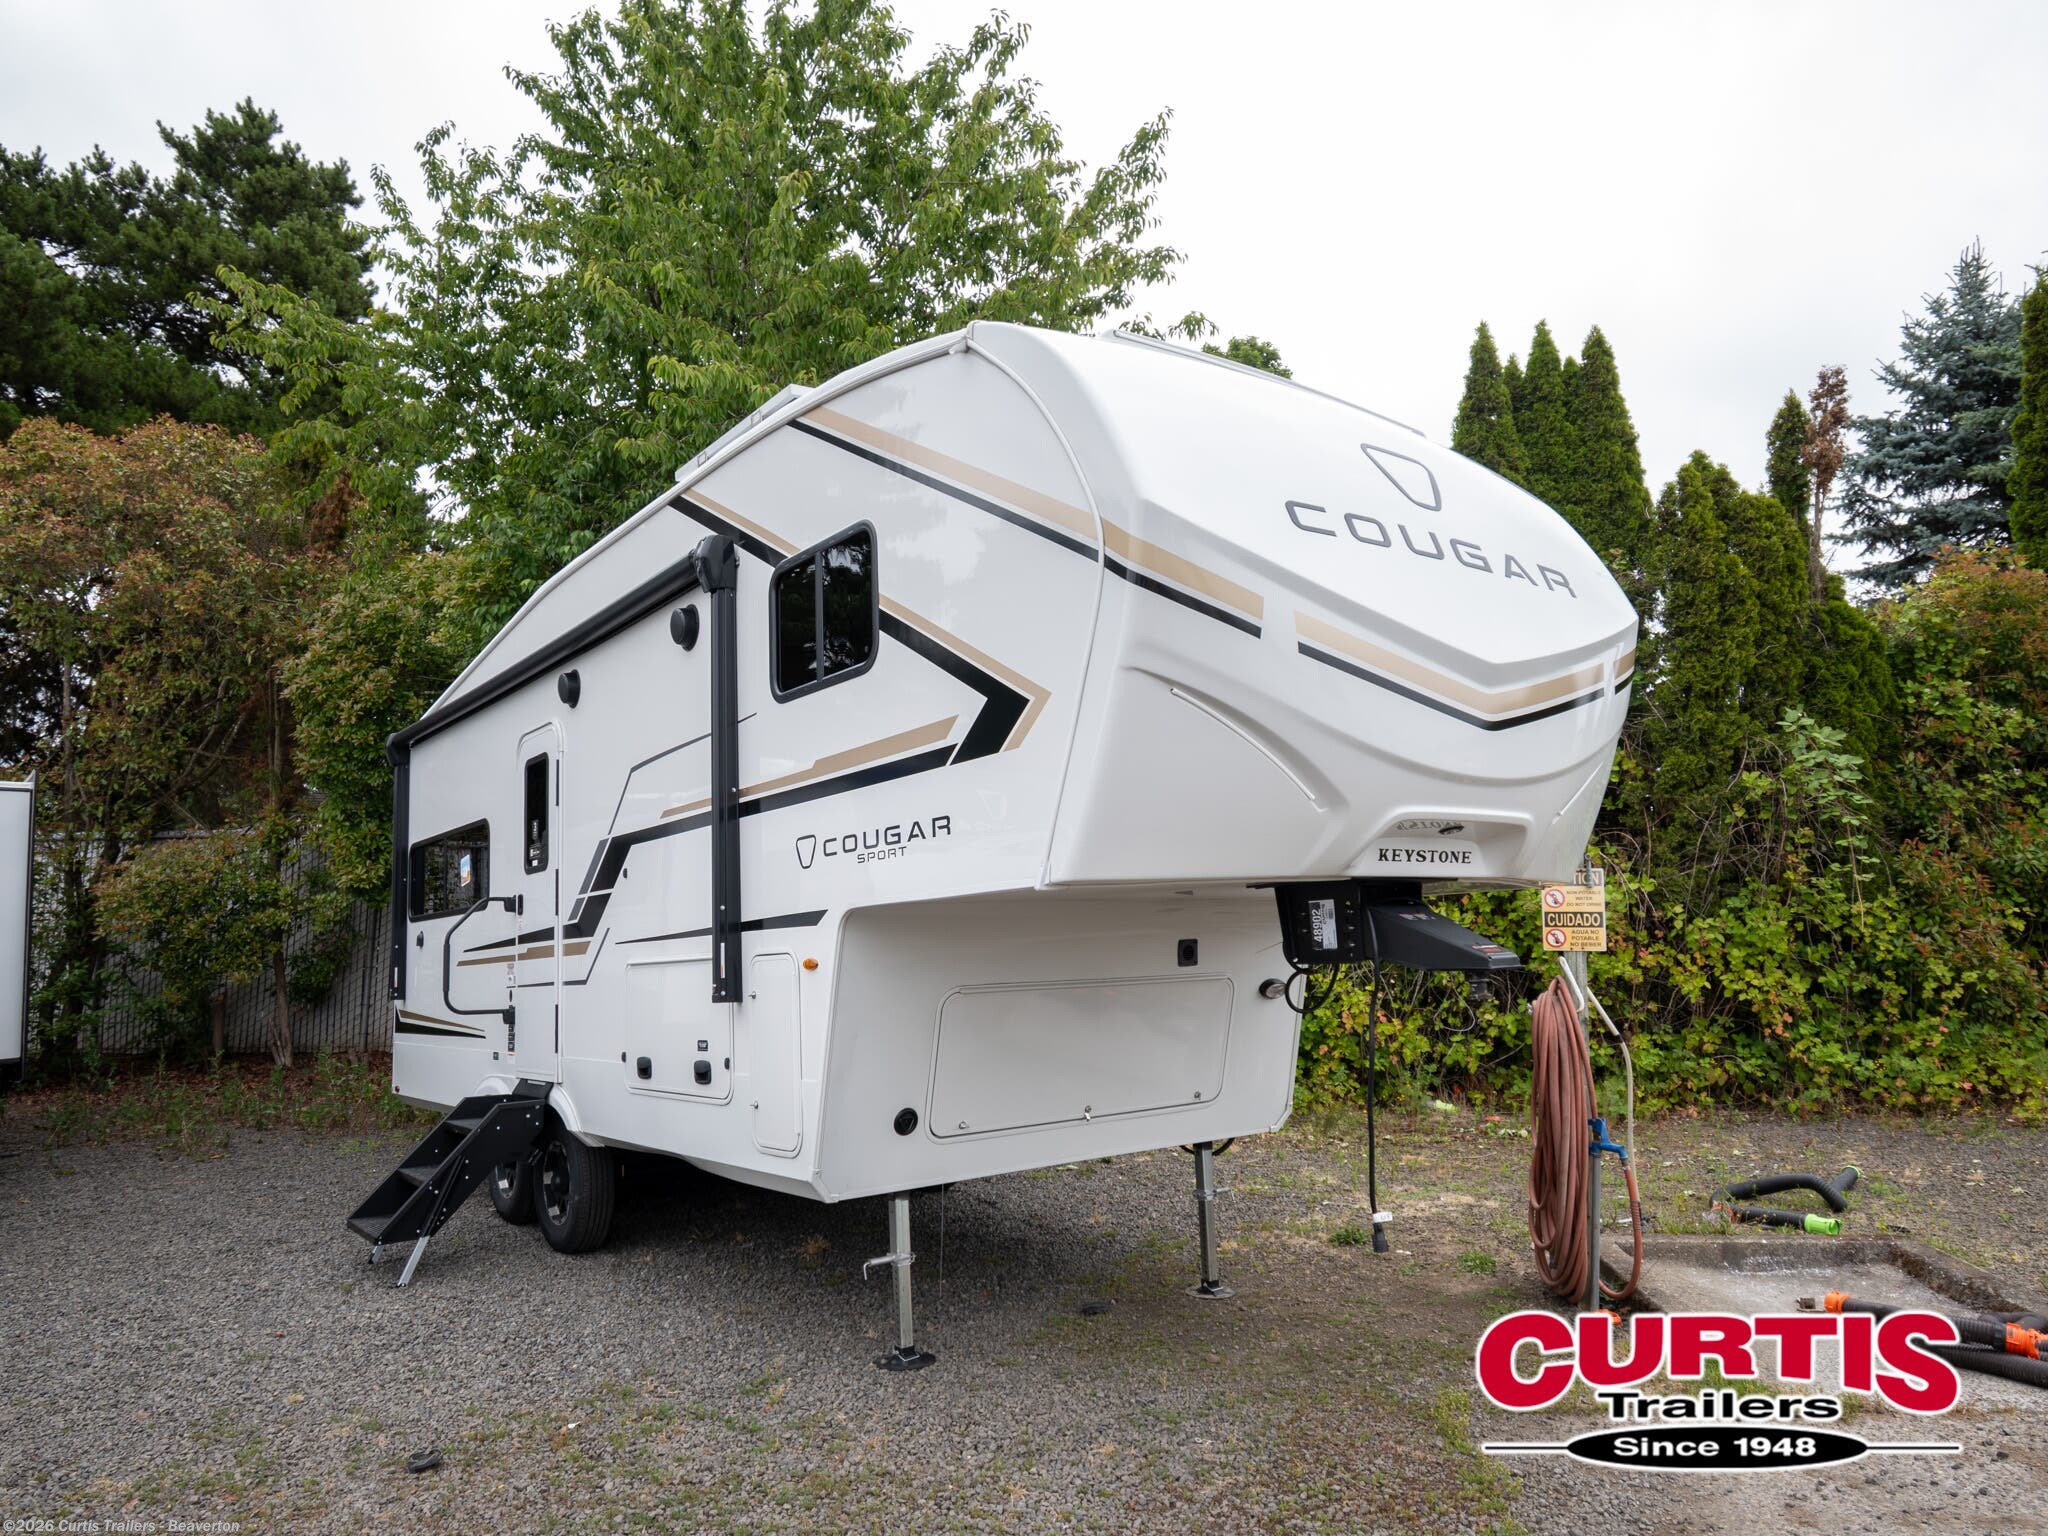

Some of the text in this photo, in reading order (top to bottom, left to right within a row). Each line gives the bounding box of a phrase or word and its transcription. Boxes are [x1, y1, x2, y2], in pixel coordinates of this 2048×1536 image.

[1285, 500, 1577, 599] COUGAR
[823, 815, 951, 857] COUGAR
[857, 846, 907, 863] SPORT
[1378, 848, 1472, 864] KEYSTONE
[1312, 909, 1323, 943] 48902
[1547, 913, 1601, 926] CUIDADO
